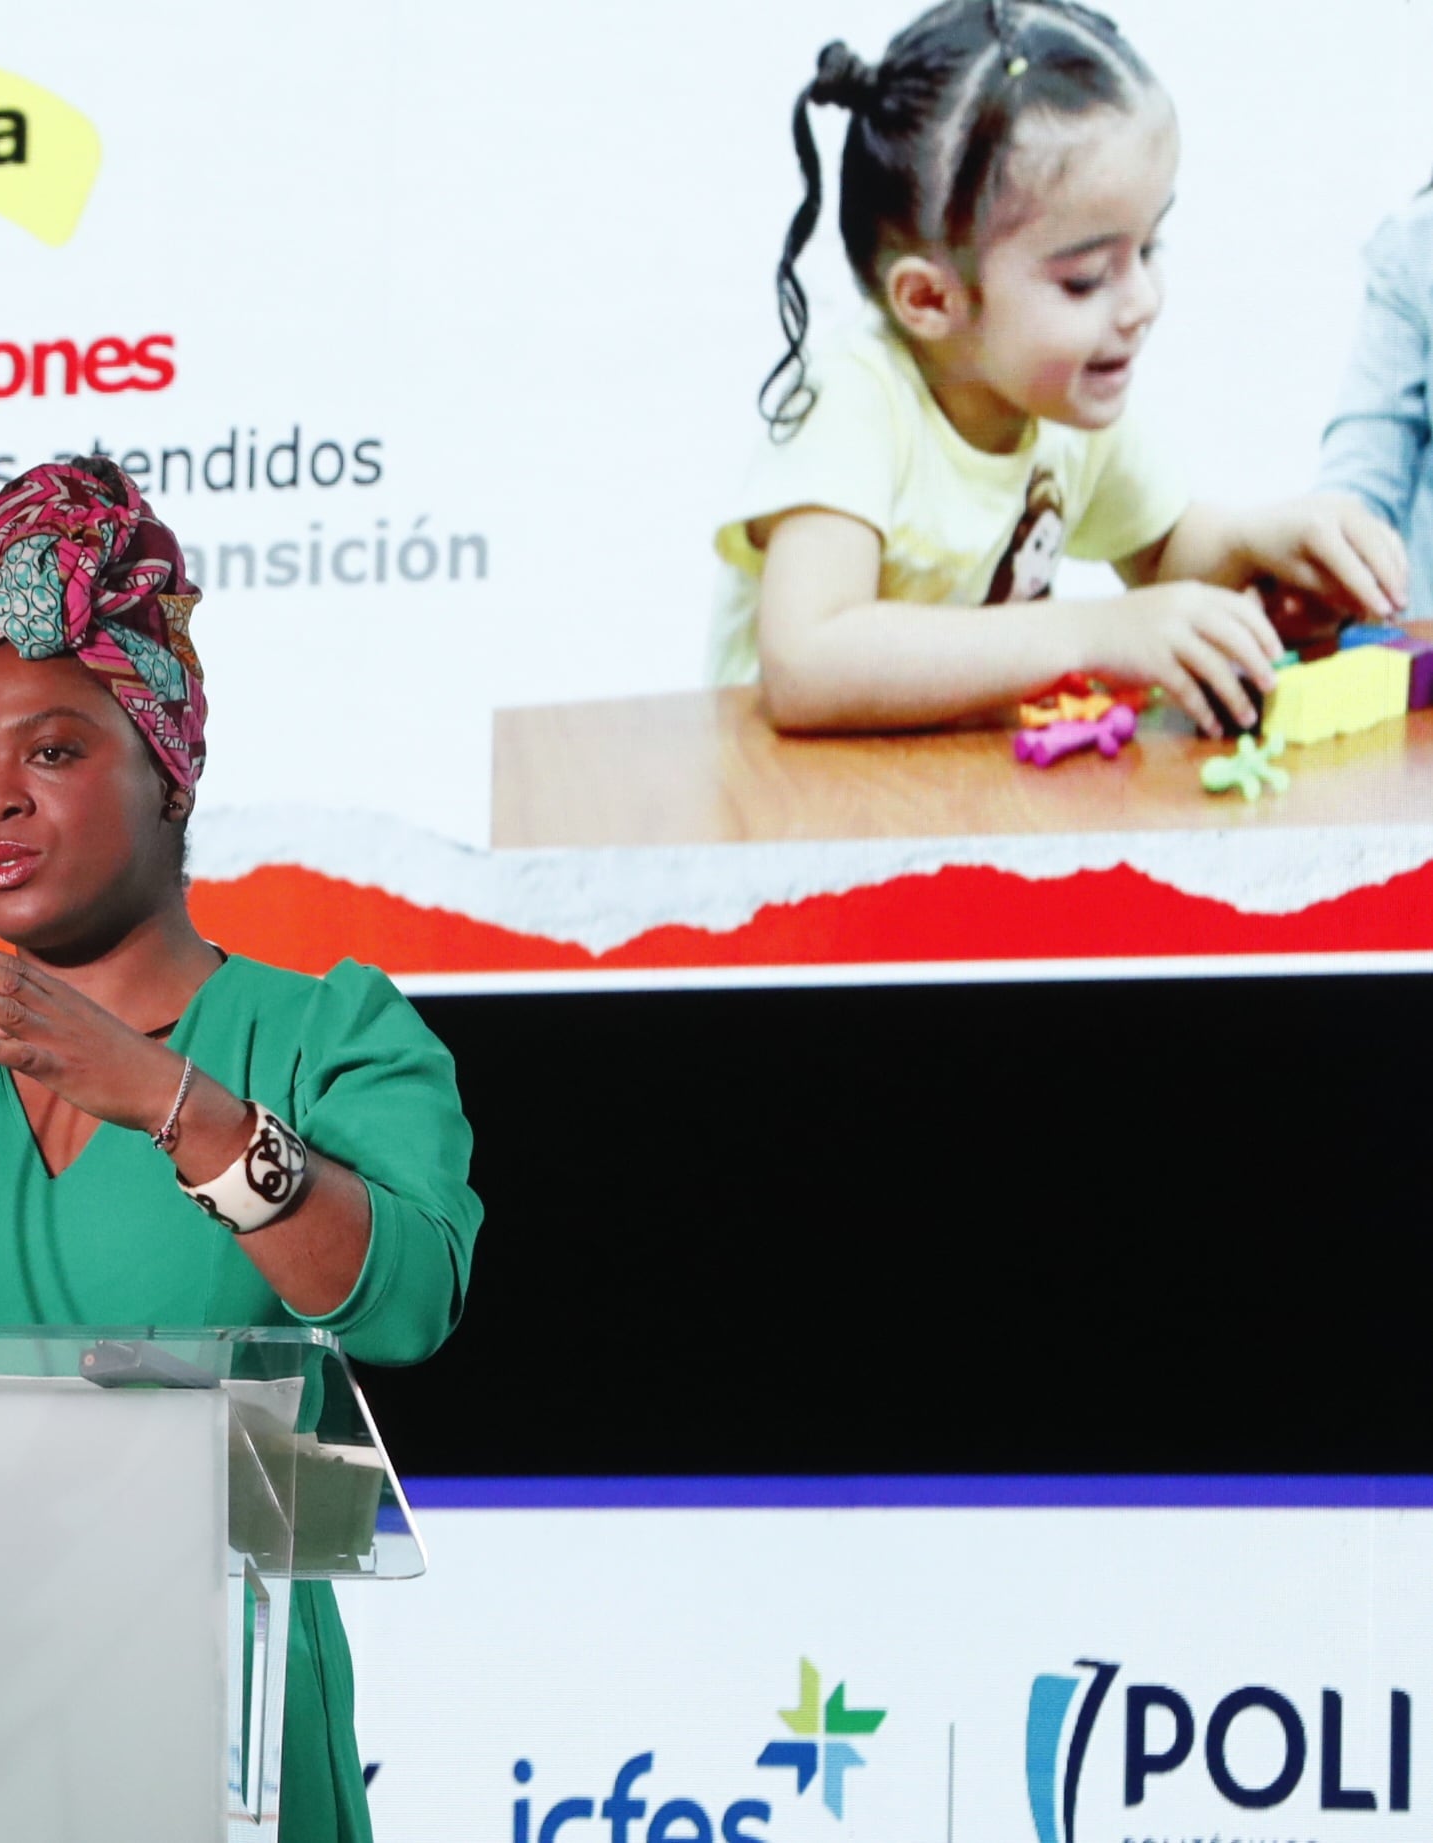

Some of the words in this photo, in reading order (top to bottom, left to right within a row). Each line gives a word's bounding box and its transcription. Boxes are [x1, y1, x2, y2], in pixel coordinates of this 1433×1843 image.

[53, 425, 384, 493] endidos
[182, 516, 489, 589] ansición
[1124, 1684, 1412, 1812] POLI
